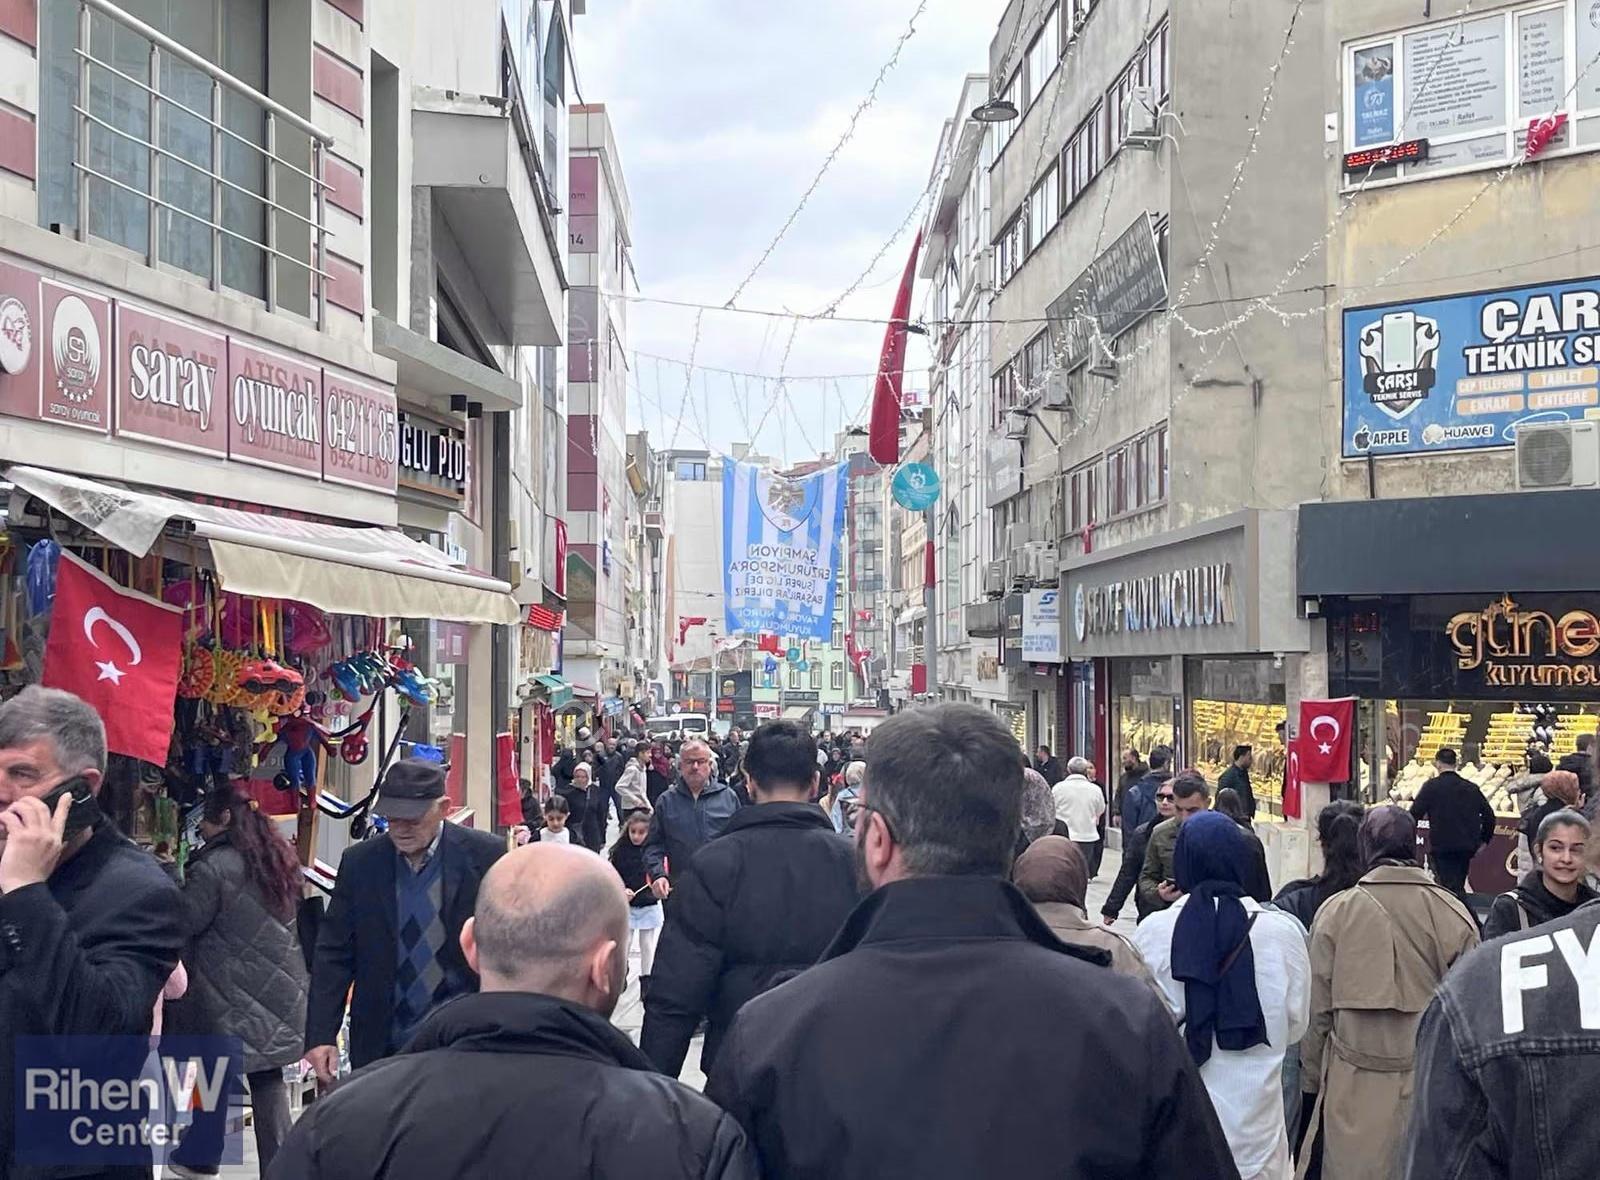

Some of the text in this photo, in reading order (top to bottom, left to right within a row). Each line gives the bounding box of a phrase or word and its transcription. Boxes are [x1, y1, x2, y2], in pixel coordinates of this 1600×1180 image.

[130, 344, 217, 431] saray
[1376, 375, 1418, 393] ÇARŞI
[1464, 335, 1566, 375] TEKNİK
[234, 374, 321, 445] oyuncak
[327, 393, 356, 453] 642
[378, 409, 396, 464] 85
[1373, 430, 1408, 446] APPLE
[1444, 426, 1494, 438] HUAWEI
[1124, 562, 1236, 632] KUYUMCULUK
[1501, 923, 1600, 1034] FY
